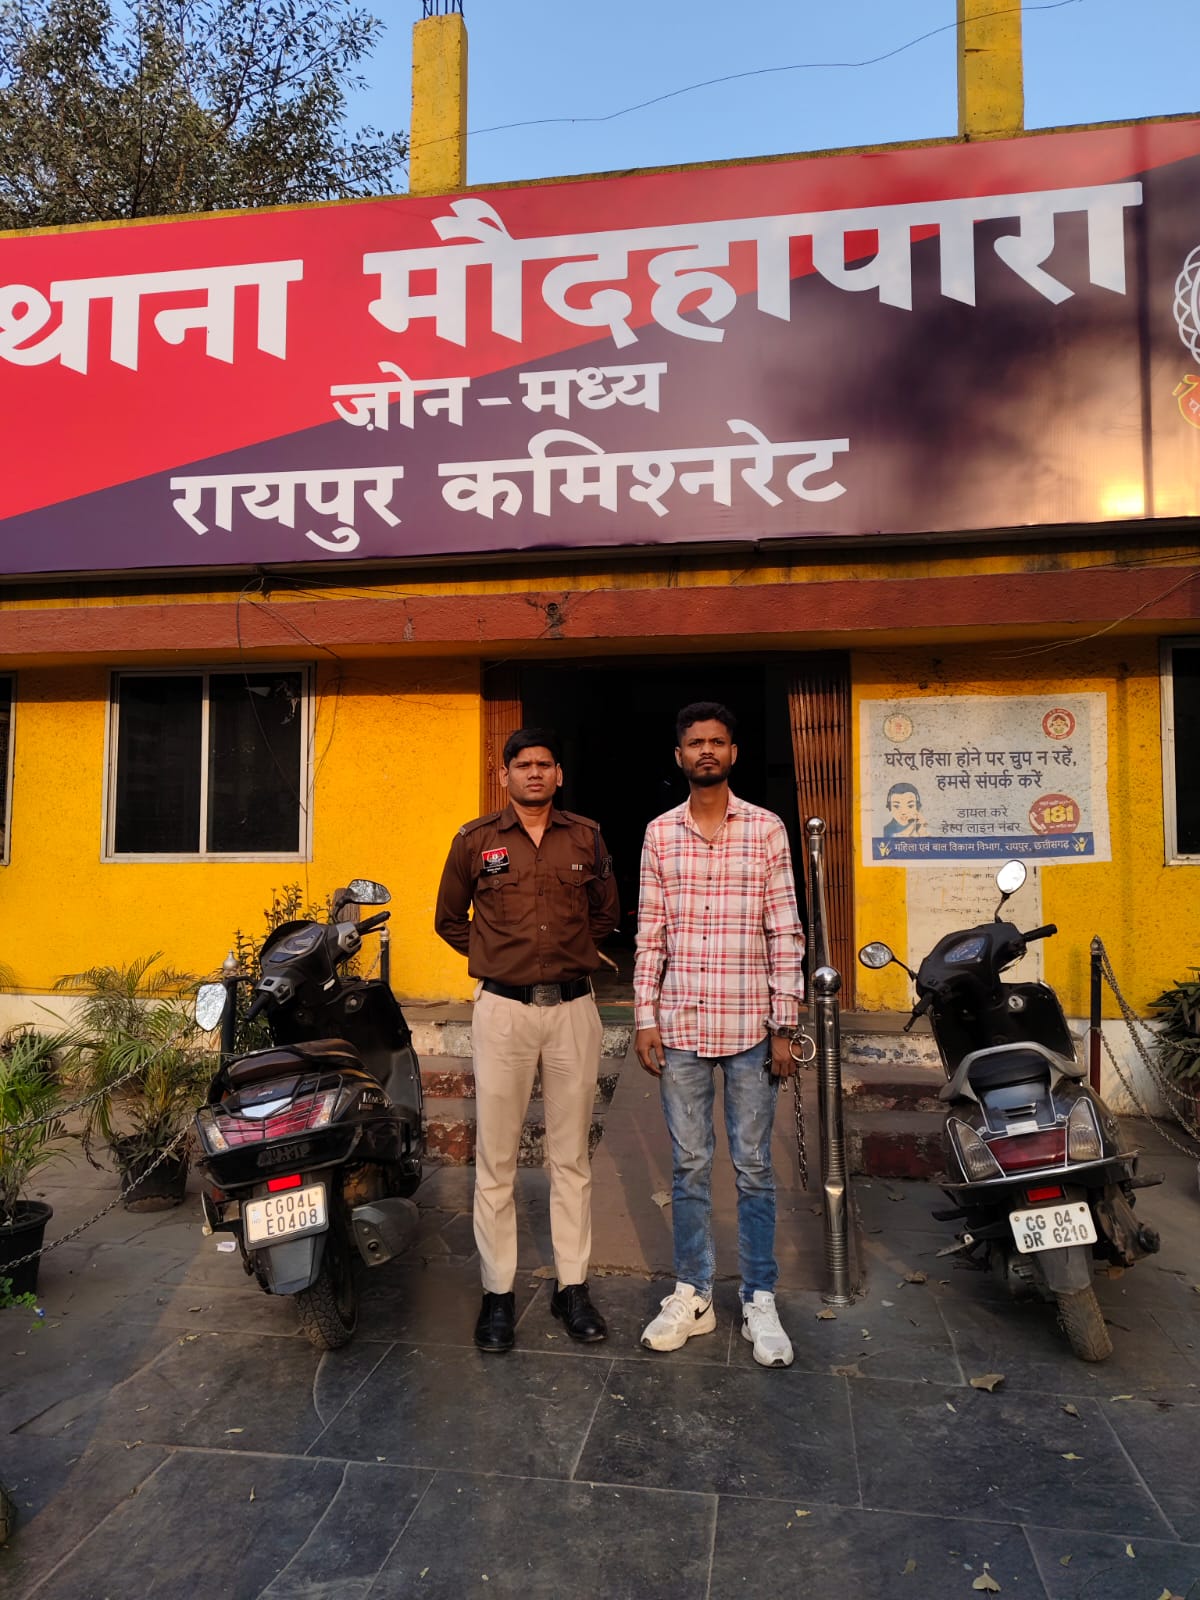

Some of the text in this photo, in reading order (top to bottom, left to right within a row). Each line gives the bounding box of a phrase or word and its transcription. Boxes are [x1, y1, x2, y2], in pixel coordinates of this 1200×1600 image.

[363, 181, 1143, 348] मौदहापारा
[170, 418, 850, 552] रायपुर कमिश्नरेट
[884, 745, 1077, 771] घरेलू हिंसा होने पर चुप न रहें,
[936, 769, 1043, 791] हमसे संपर्क करें
[956, 808, 987, 818] डायल
[1042, 804, 1074, 824] 181
[966, 823, 994, 834] लाइन
[895, 841, 917, 853] महिला
[1025, 1209, 1073, 1231] CG 04
[1023, 1224, 1088, 1249] DR 6210
